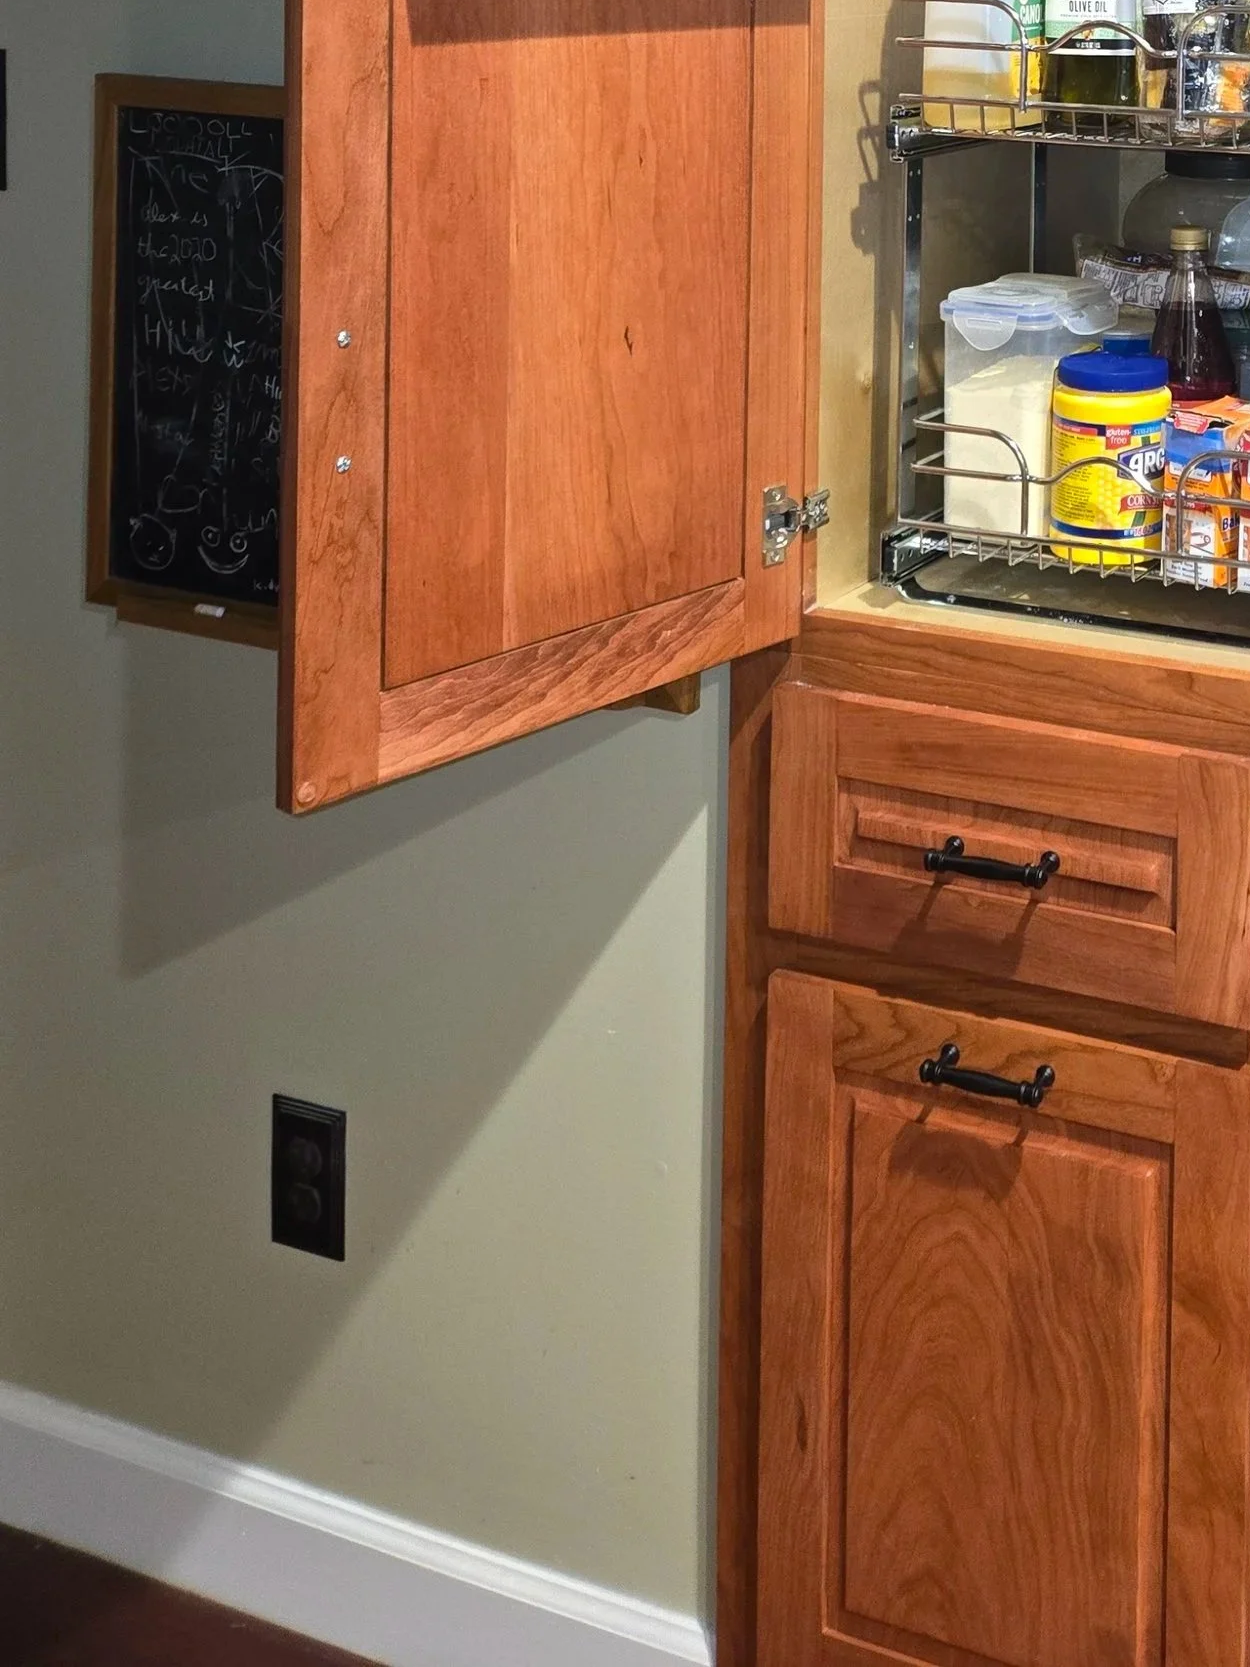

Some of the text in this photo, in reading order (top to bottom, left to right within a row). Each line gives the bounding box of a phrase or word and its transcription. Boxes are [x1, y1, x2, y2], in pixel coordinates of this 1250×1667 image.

[1069, 0, 1107, 13] OLIVE OIL
[1110, 436, 1127, 445] free
[1129, 447, 1165, 475] ARG
[1127, 495, 1151, 507] CORN
